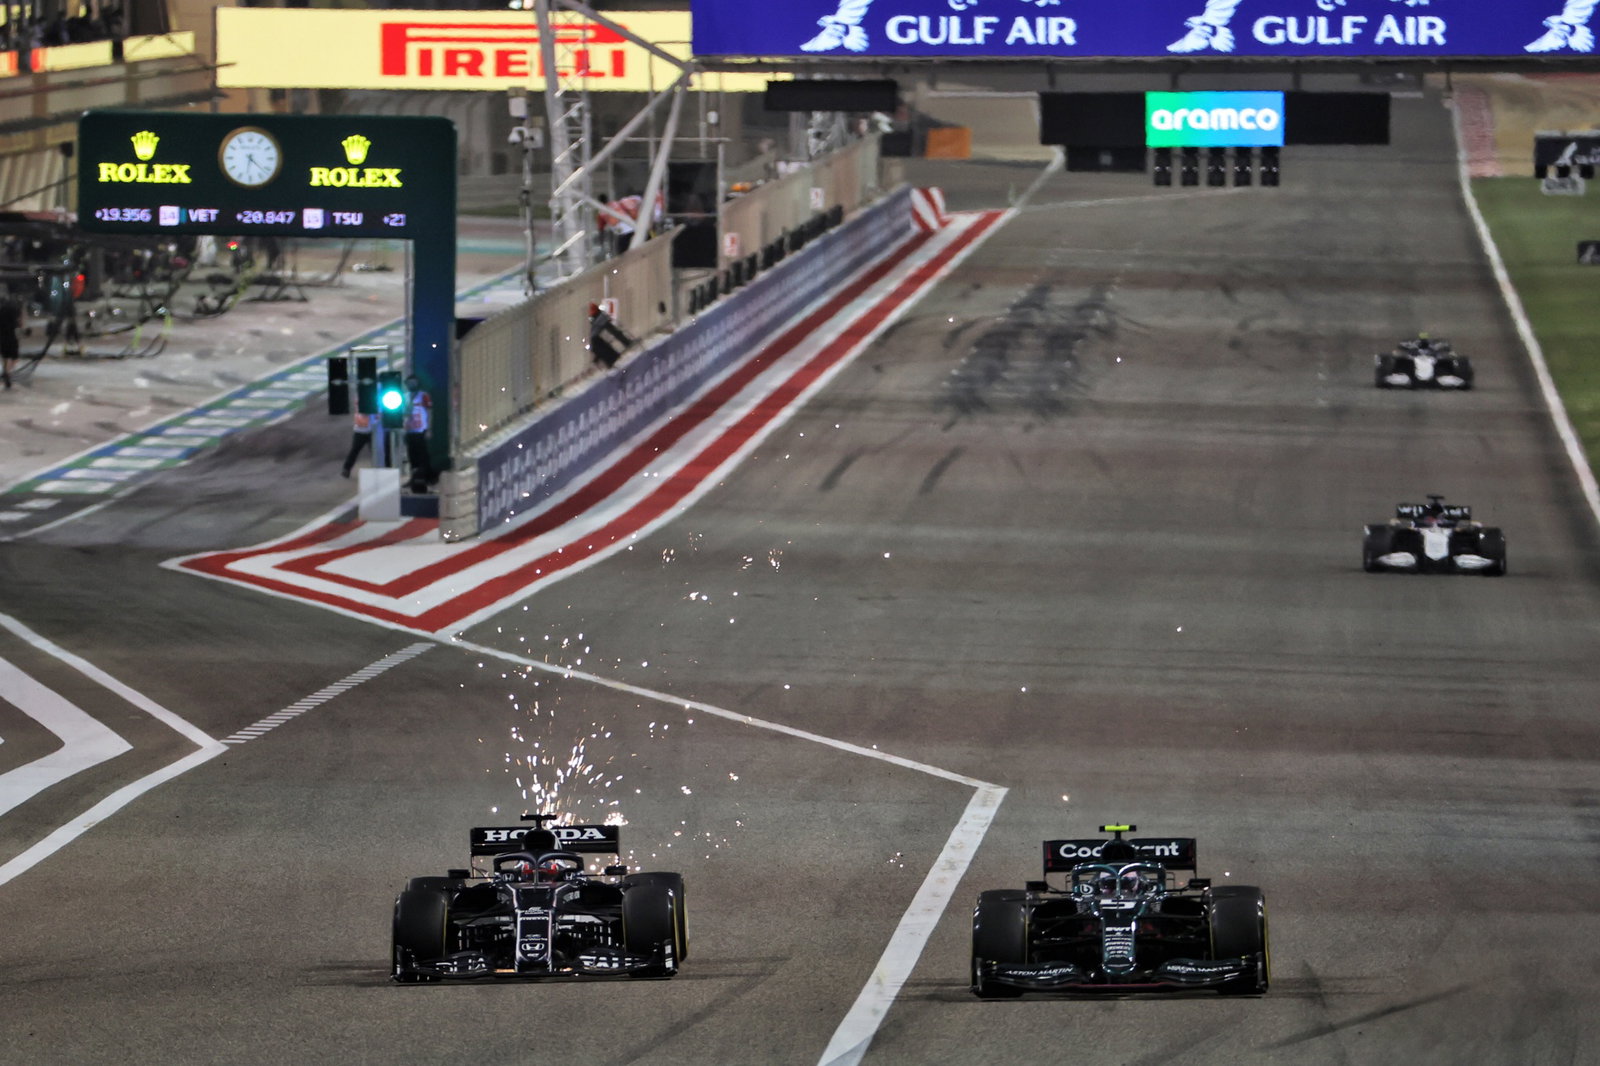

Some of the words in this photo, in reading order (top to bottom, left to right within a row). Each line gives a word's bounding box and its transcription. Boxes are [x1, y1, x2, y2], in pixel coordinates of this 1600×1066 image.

[885, 15, 1000, 45] GULF
[1005, 16, 1077, 45] AIR
[1252, 15, 1368, 45] GULF
[1374, 14, 1447, 45] AIR
[1151, 108, 1279, 131] aramco
[98, 162, 192, 183] ROLEX
[310, 167, 403, 188] ROLEX
[188, 209, 219, 222] VET
[333, 212, 363, 225] TSU
[484, 828, 606, 841] HODA
